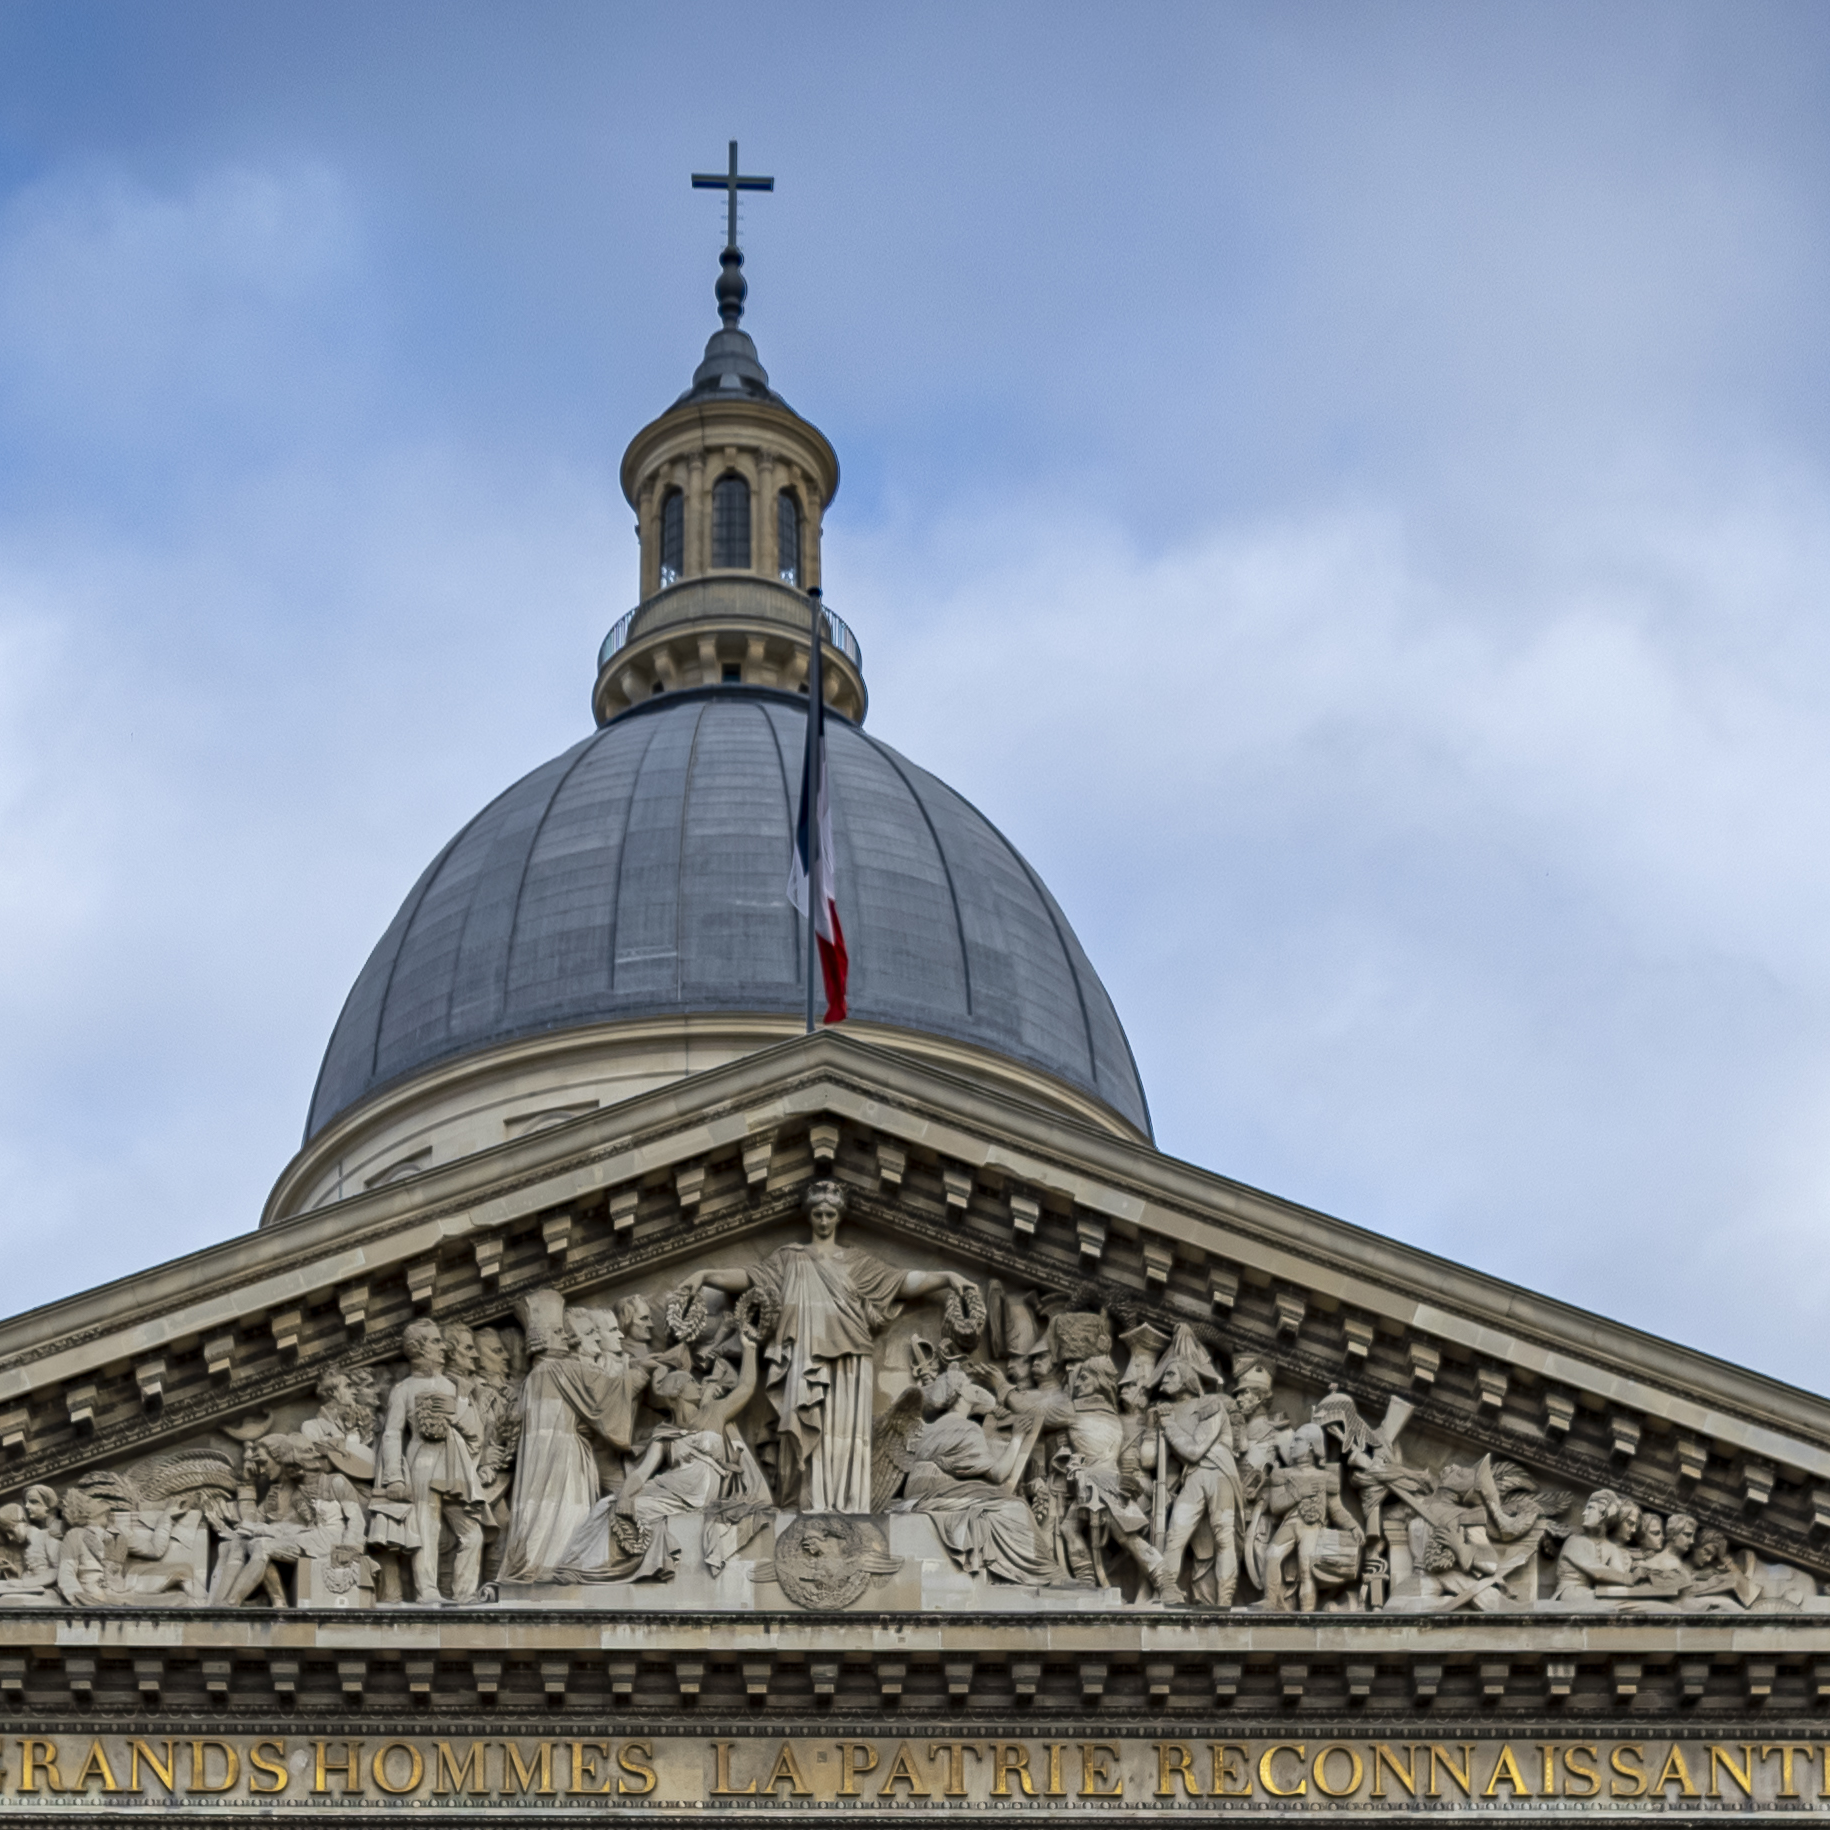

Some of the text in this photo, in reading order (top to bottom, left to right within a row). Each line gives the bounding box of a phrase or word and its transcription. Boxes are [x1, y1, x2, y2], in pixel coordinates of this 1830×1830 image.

[309, 1740, 658, 1795] HOMMES
[709, 1742, 814, 1796] LA
[835, 1742, 1124, 1797] PATRIE
